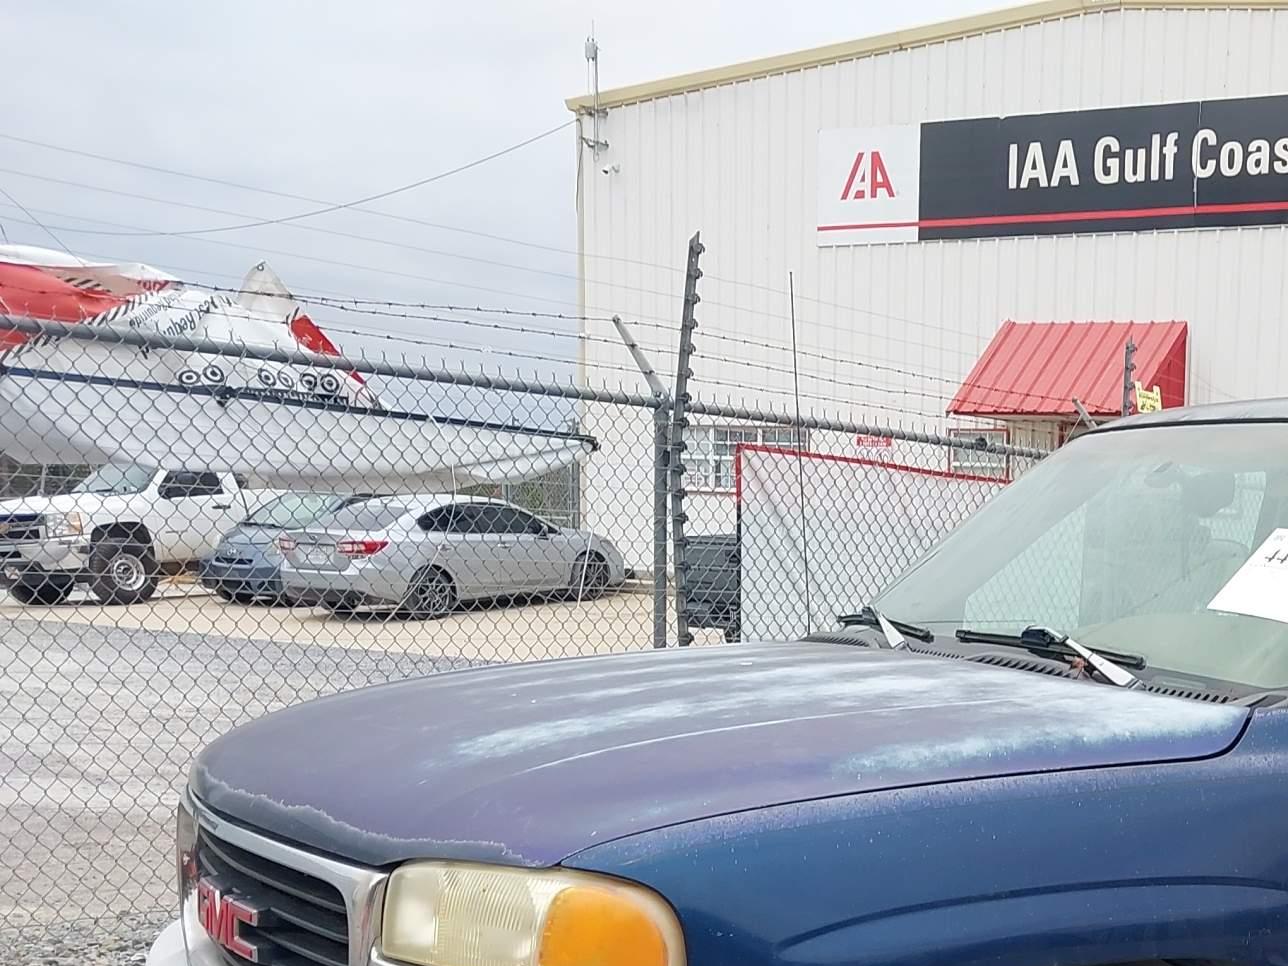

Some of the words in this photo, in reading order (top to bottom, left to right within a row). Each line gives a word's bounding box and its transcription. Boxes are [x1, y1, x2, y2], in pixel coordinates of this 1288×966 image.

[1008, 138, 1080, 190] IAA
[1093, 130, 1179, 184] Gulf
[198, 878, 258, 963] GMC
